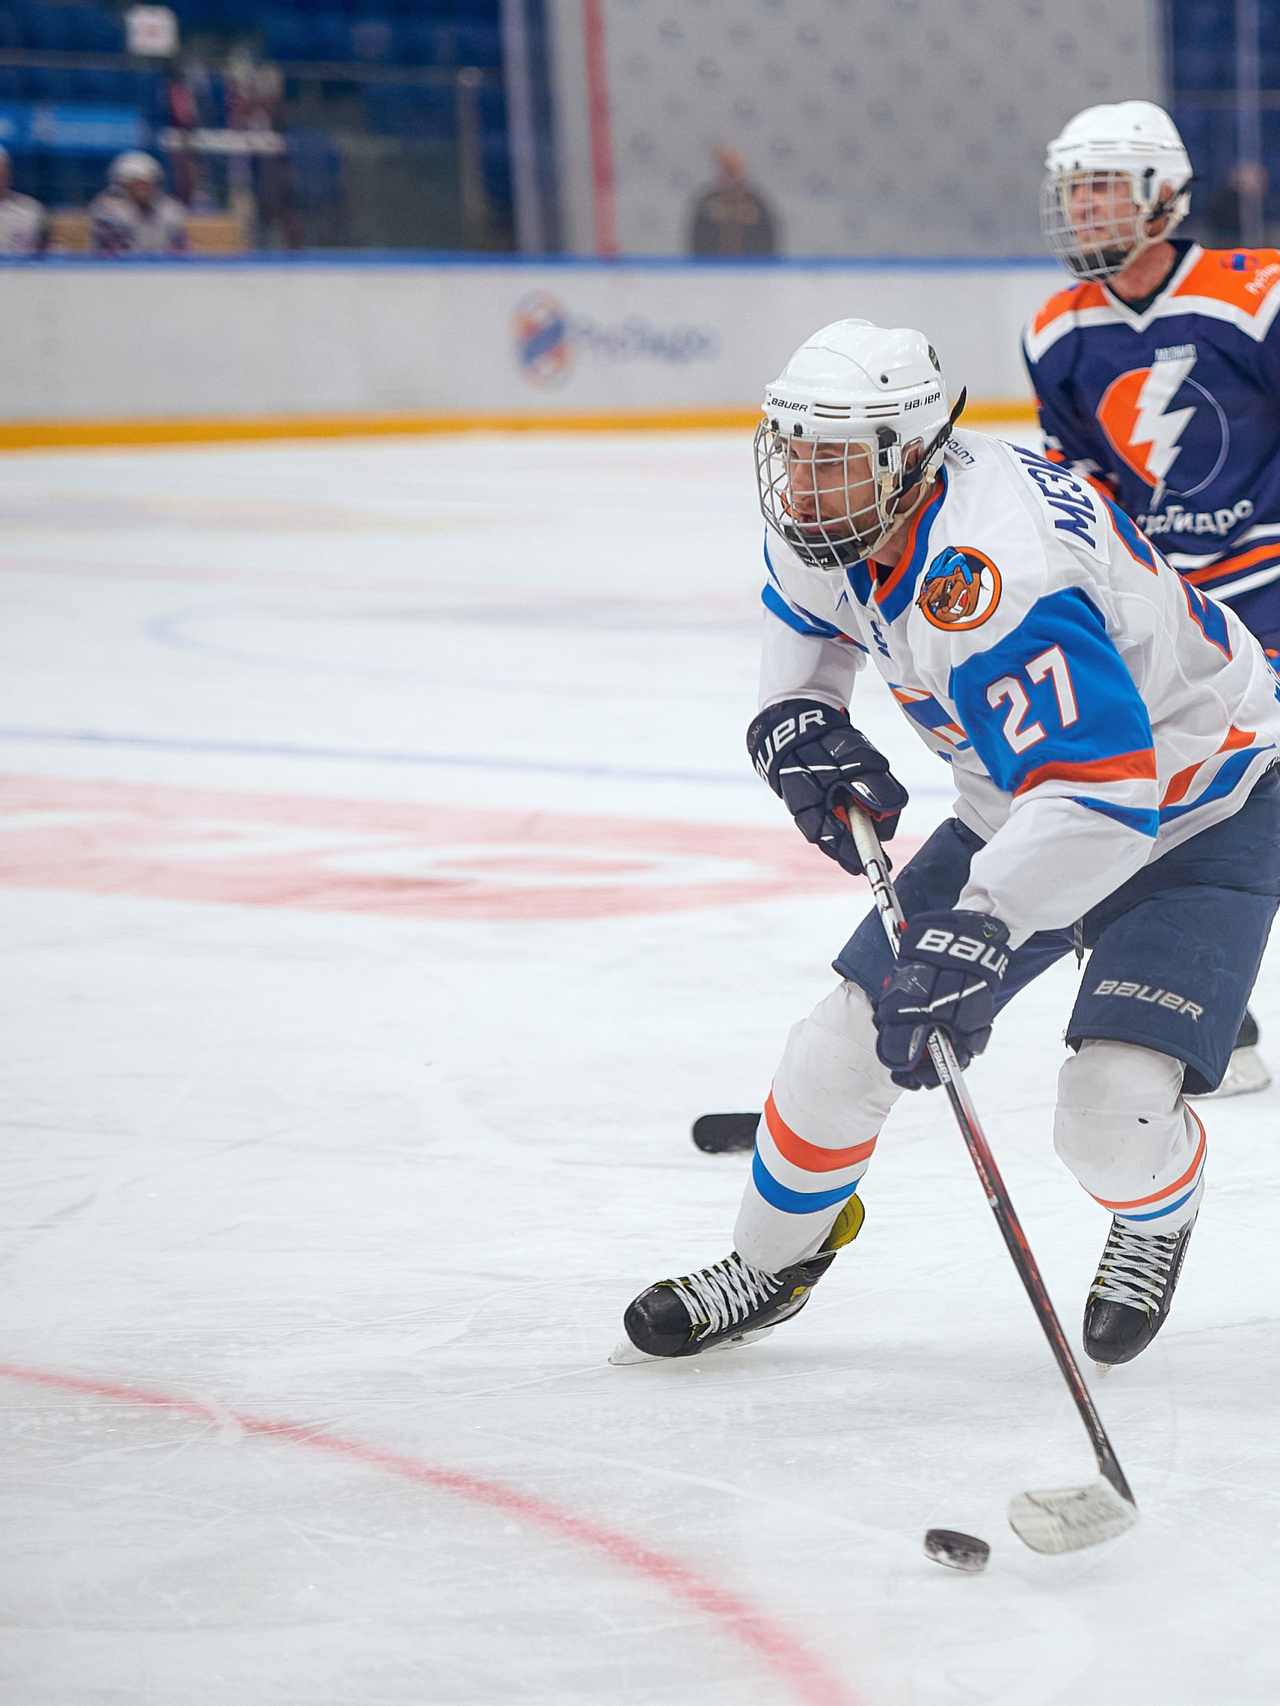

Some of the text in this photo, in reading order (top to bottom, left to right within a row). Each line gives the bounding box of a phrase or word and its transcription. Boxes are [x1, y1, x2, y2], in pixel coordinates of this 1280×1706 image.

[771, 397, 808, 412] BAUER
[904, 391, 941, 411] BAUER
[986, 643, 1079, 756] 27
[1092, 980, 1204, 1023] BAUER
